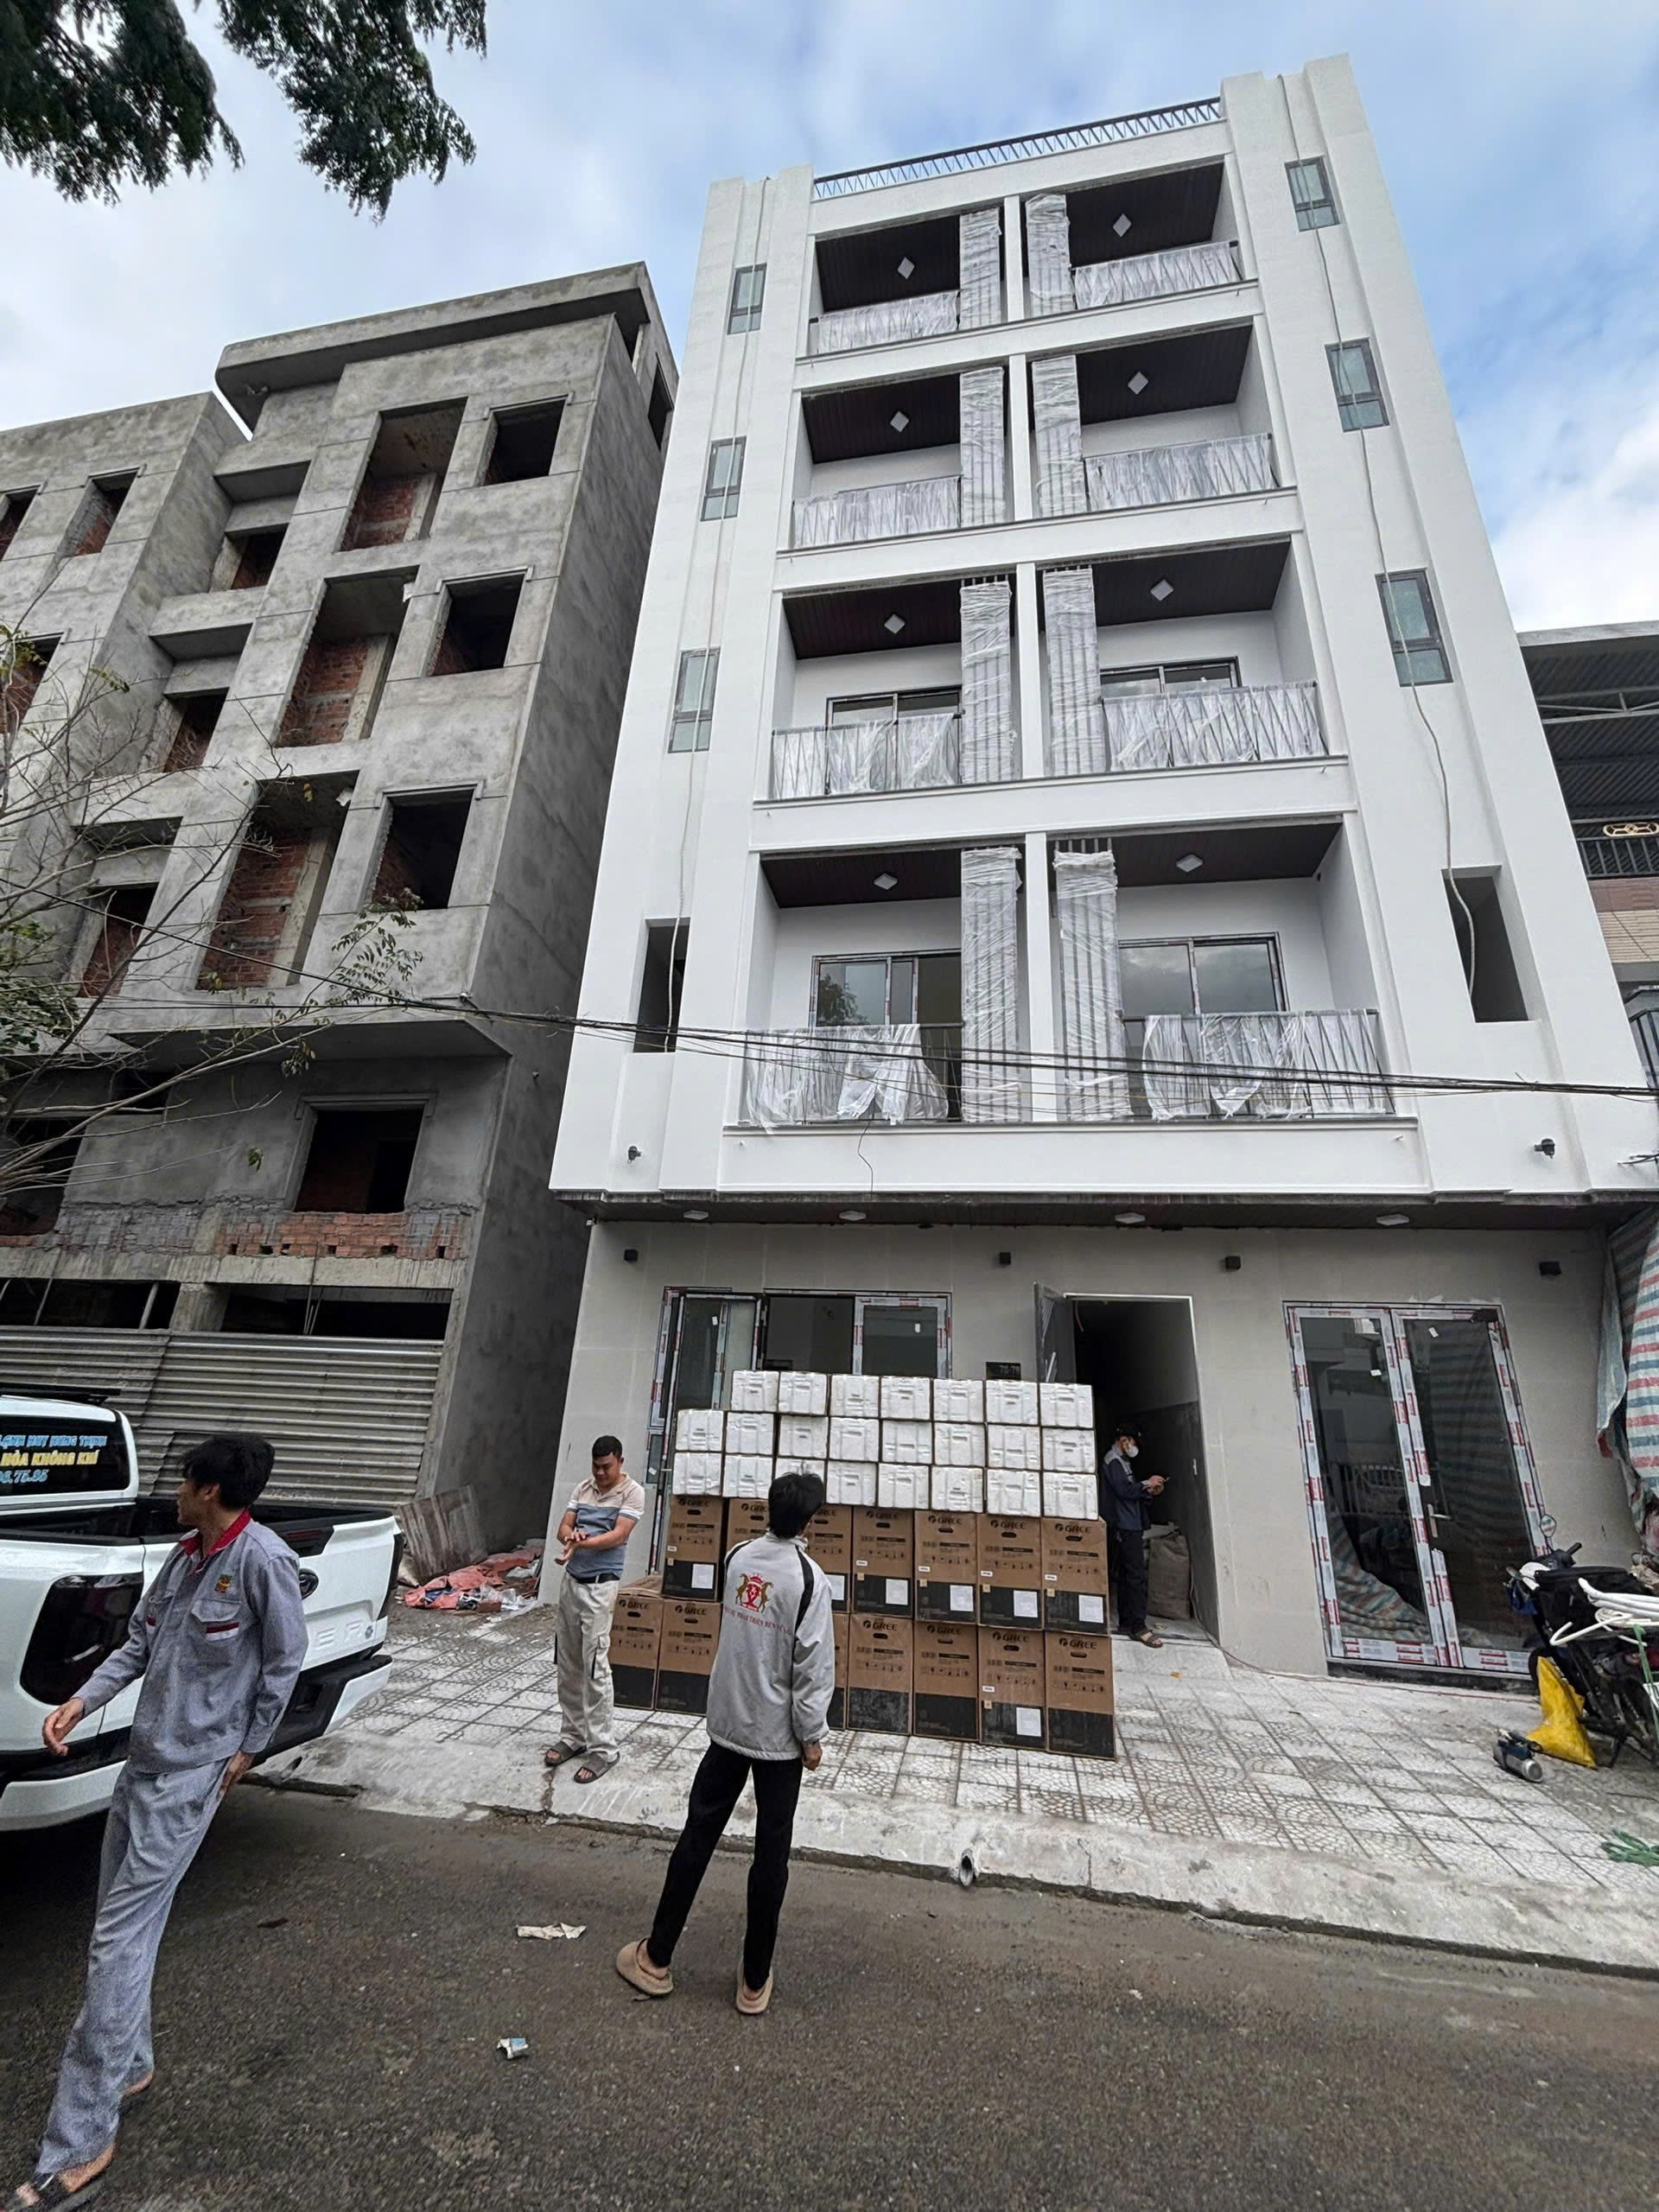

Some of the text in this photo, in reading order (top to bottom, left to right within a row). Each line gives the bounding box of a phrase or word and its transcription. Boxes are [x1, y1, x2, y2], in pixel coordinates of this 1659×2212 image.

[27, 1435, 49, 1447] HUY
[31, 1450, 76, 1465] KHÔNG
[77, 1449, 100, 1465] KHÍ
[750, 1504, 767, 1513] GRE
[938, 1516, 962, 1525] GREE
[1001, 1521, 1027, 1529] GREE
[1065, 1525, 1091, 1534] GREE
[627, 1601, 650, 1610] GREE
[684, 1607, 707, 1616] GREE
[873, 1622, 897, 1631] GREE
[937, 1625, 961, 1635] GREE
[1002, 1632, 1029, 1642] GREE
[1070, 1638, 1097, 1649] GREE
